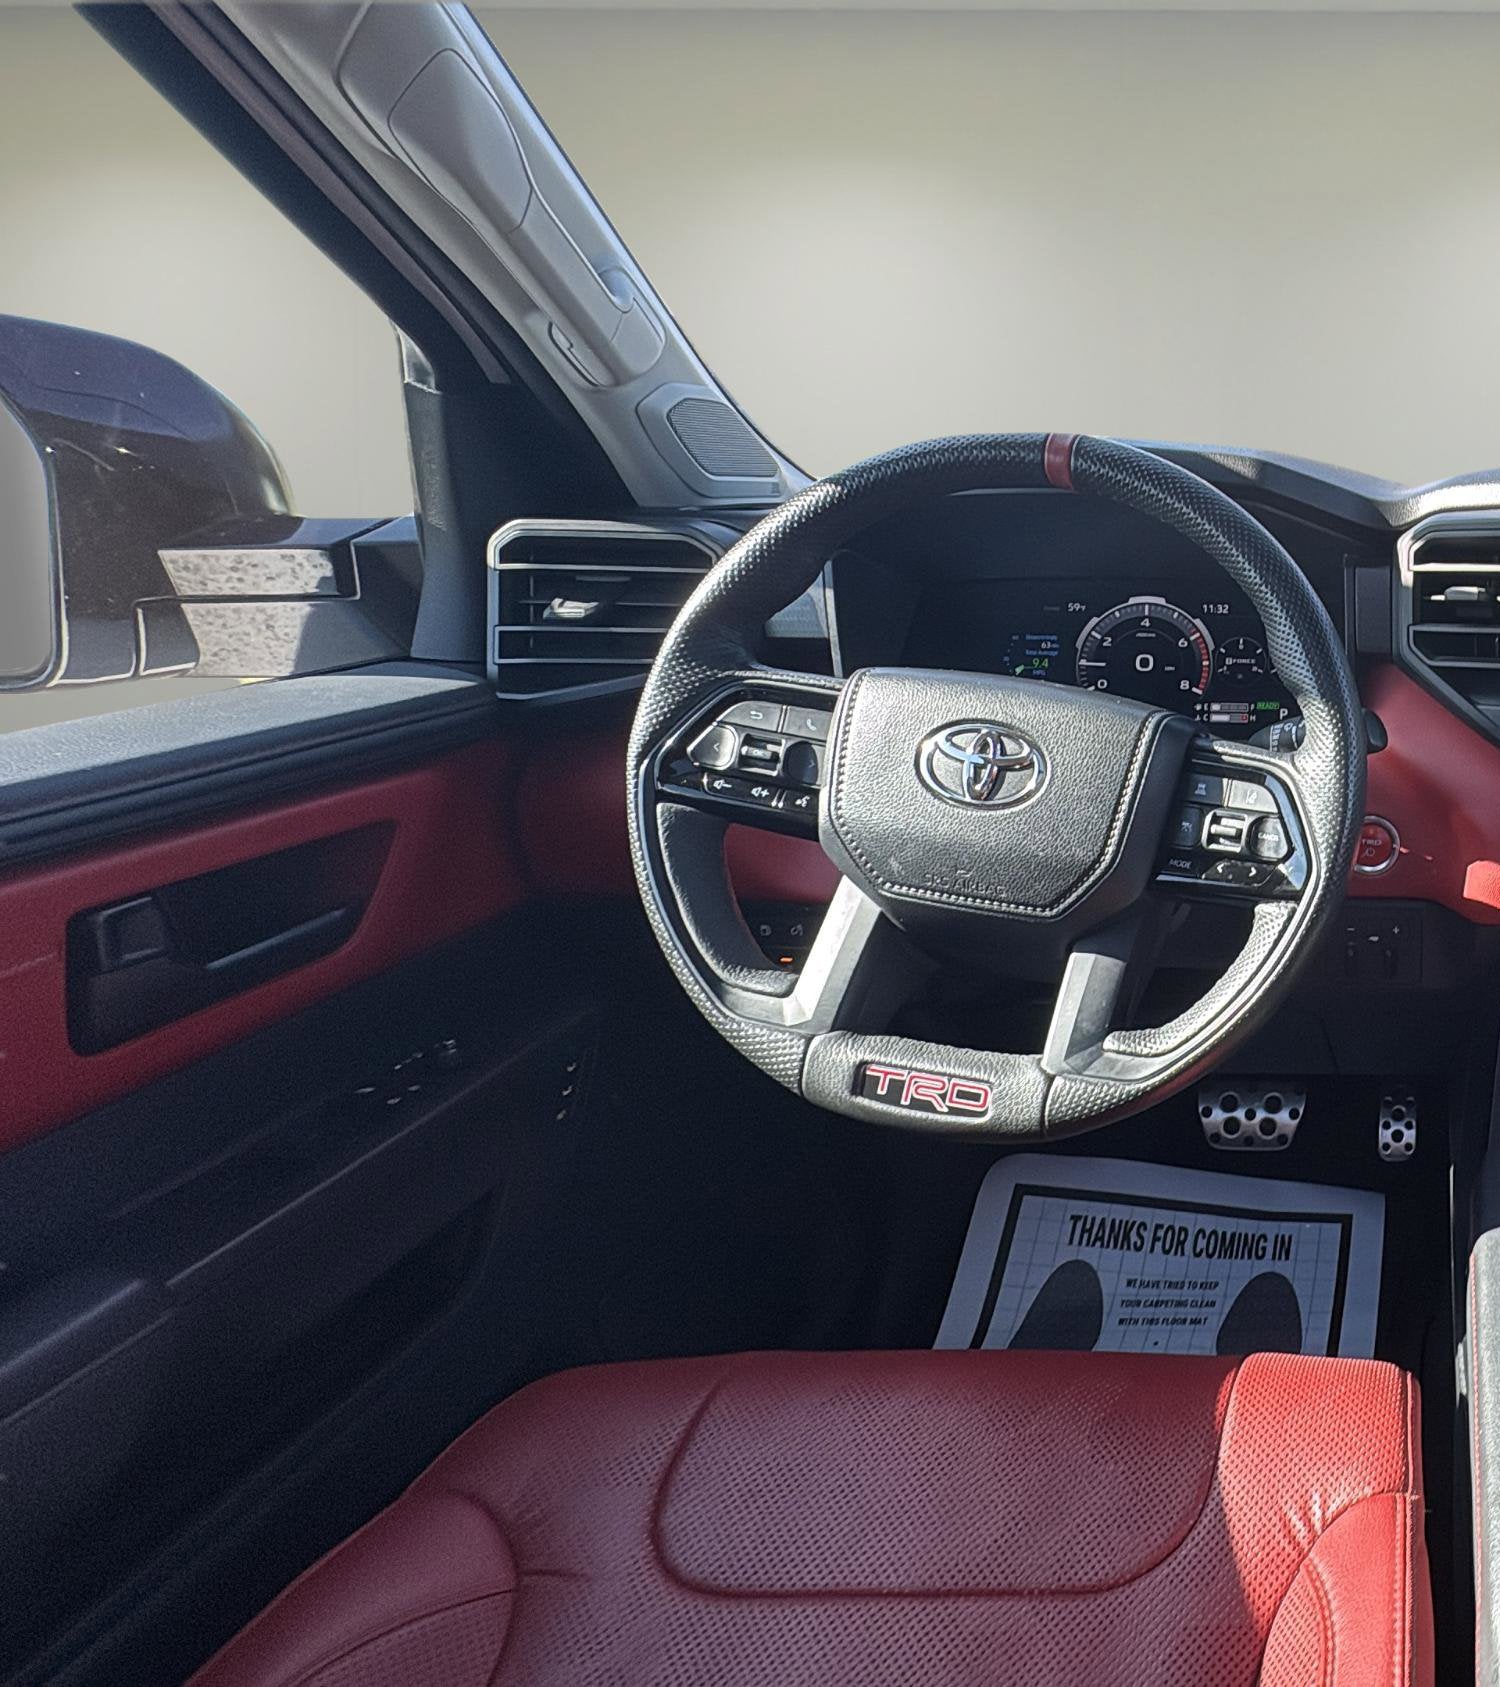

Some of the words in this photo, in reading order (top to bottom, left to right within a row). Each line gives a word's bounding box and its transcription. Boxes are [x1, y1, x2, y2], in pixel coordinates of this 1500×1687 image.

[1202, 603, 1229, 614] 11:32
[1140, 617, 1151, 628] 4
[1102, 636, 1112, 647] 2
[1178, 638, 1188, 648] 6
[1135, 653, 1154, 672] 0
[1097, 679, 1107, 689] 0
[1180, 680, 1190, 690] 8
[1279, 708, 1289, 720] P
[1169, 859, 1192, 869] MODE
[866, 1064, 992, 1113] TRD
[1068, 1214, 1147, 1252] THANKS
[1149, 1223, 1189, 1257] FOR
[1192, 1228, 1268, 1261] COMING
[1271, 1232, 1293, 1261] IN
[1126, 1279, 1138, 1288] WE
[1138, 1280, 1161, 1289] HAVE
[1163, 1281, 1185, 1290] TRIED
[1187, 1281, 1198, 1290] TO
[1199, 1281, 1219, 1290] KEEP
[1121, 1300, 1142, 1308] YOUR
[1143, 1300, 1188, 1308] CARPETING
[1189, 1300, 1216, 1308] CLEAN
[1118, 1317, 1139, 1326] WITH
[1140, 1317, 1160, 1326] THIS
[1161, 1317, 1187, 1326] FLOOR
[1188, 1317, 1208, 1326] MAT
